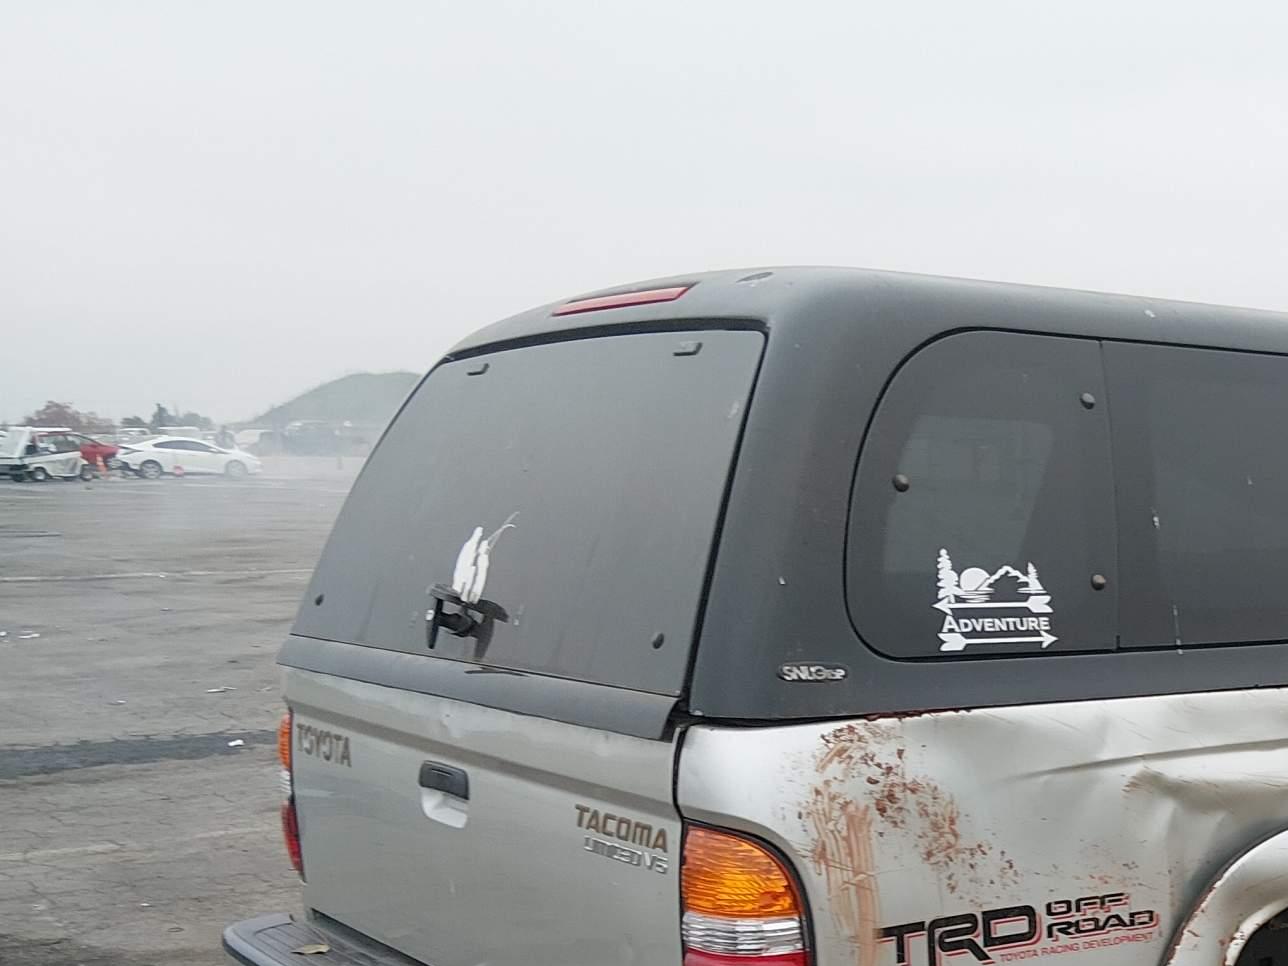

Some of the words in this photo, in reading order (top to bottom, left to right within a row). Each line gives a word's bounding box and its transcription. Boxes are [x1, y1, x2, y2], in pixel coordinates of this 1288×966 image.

[942, 614, 1051, 633] ADVENTURE
[296, 722, 352, 768] TOYOTA
[574, 803, 669, 853] TACOMA
[1046, 892, 1130, 919] OFF
[1046, 909, 1160, 942] ROAD
[999, 949, 1039, 963] TOYOTA
[1041, 943, 1081, 958] RACING
[1083, 932, 1154, 953] DEVELOPMENT
